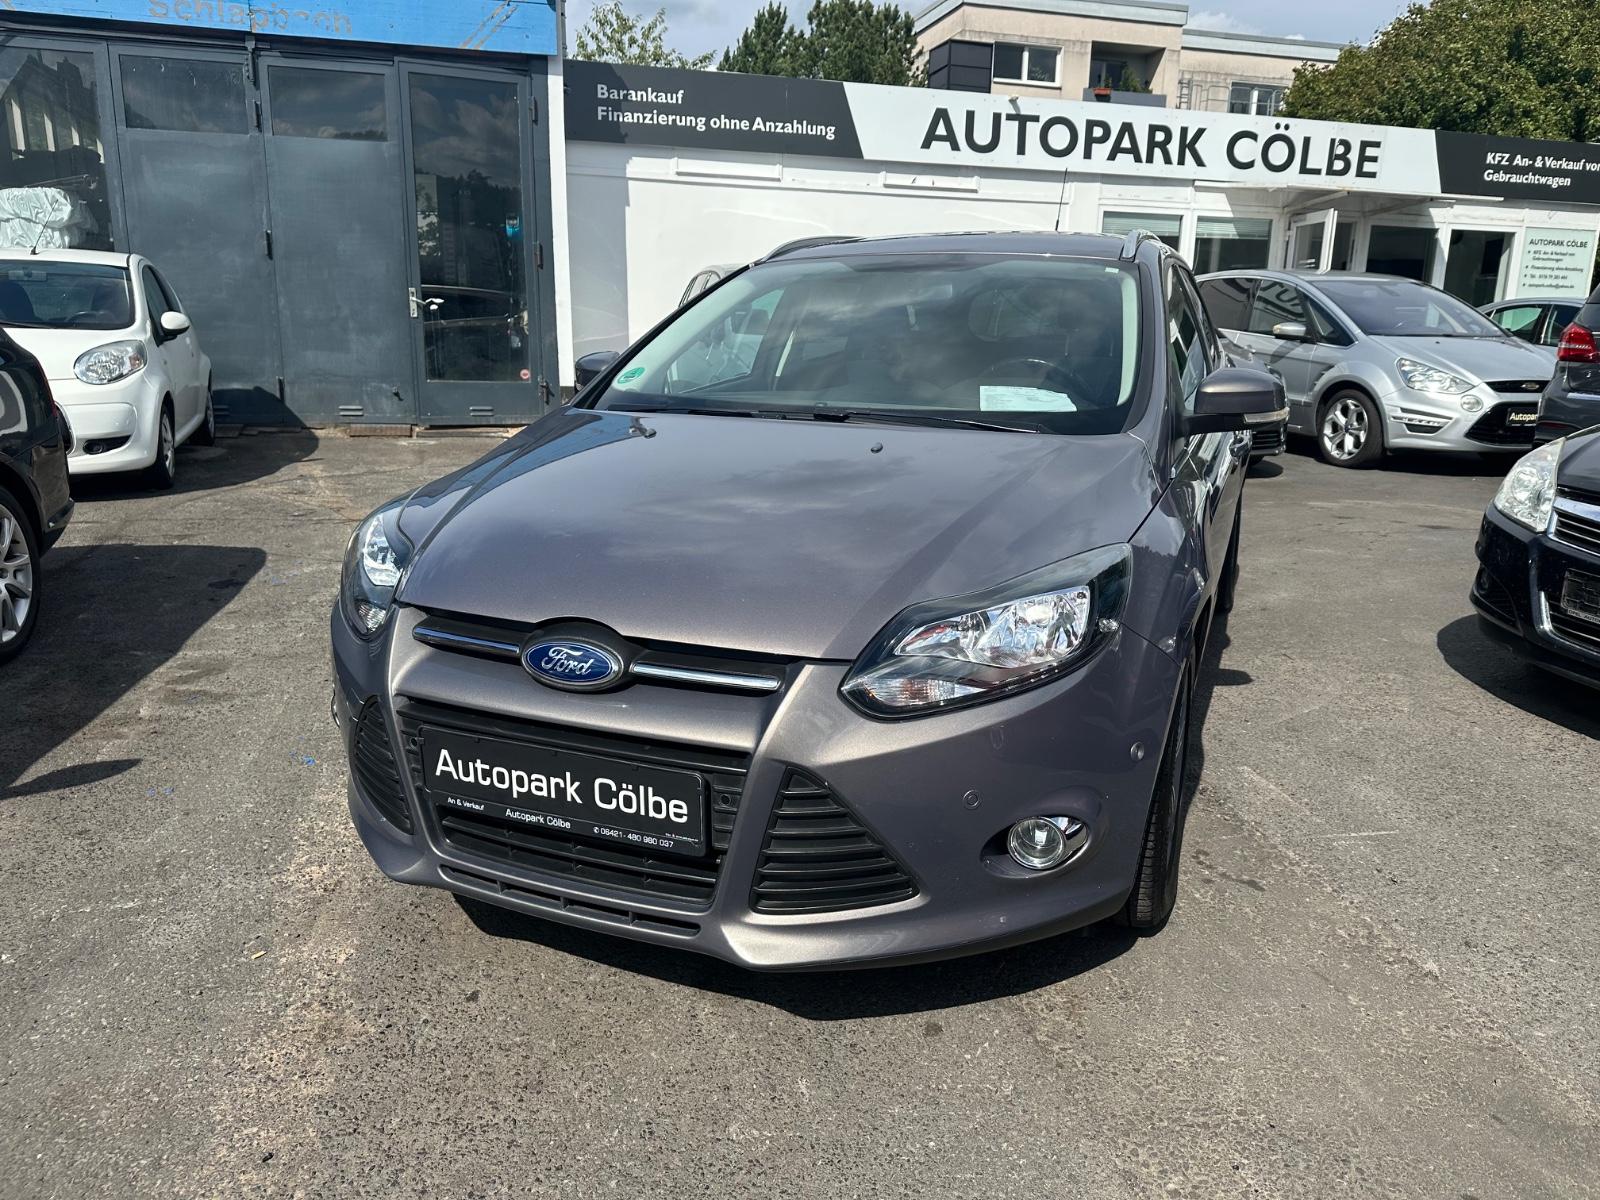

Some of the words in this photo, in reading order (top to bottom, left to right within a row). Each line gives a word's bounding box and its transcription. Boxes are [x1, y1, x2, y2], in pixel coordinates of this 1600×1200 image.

[596, 83, 684, 105] Barankauf
[597, 106, 706, 131] Finanzierung
[710, 113, 749, 131] ohne
[751, 117, 836, 141] Anzahlung
[919, 107, 1207, 167] AUTOPARK
[1226, 121, 1382, 179] CÖLBE
[1486, 152, 1510, 165] KFZ
[1513, 154, 1533, 167] An-
[1535, 156, 1543, 168] &
[1545, 156, 1585, 171] Verkauf
[1483, 169, 1571, 188] Gebrauchtwagen
[1529, 238, 1565, 247] AUTOPARK
[541, 646, 595, 675] Ford
[435, 748, 583, 804] Autopark
[593, 777, 689, 824] Cölbe
[462, 800, 485, 811] Verkauf
[505, 808, 544, 824] Autopark
[546, 816, 572, 829] Cölbe
